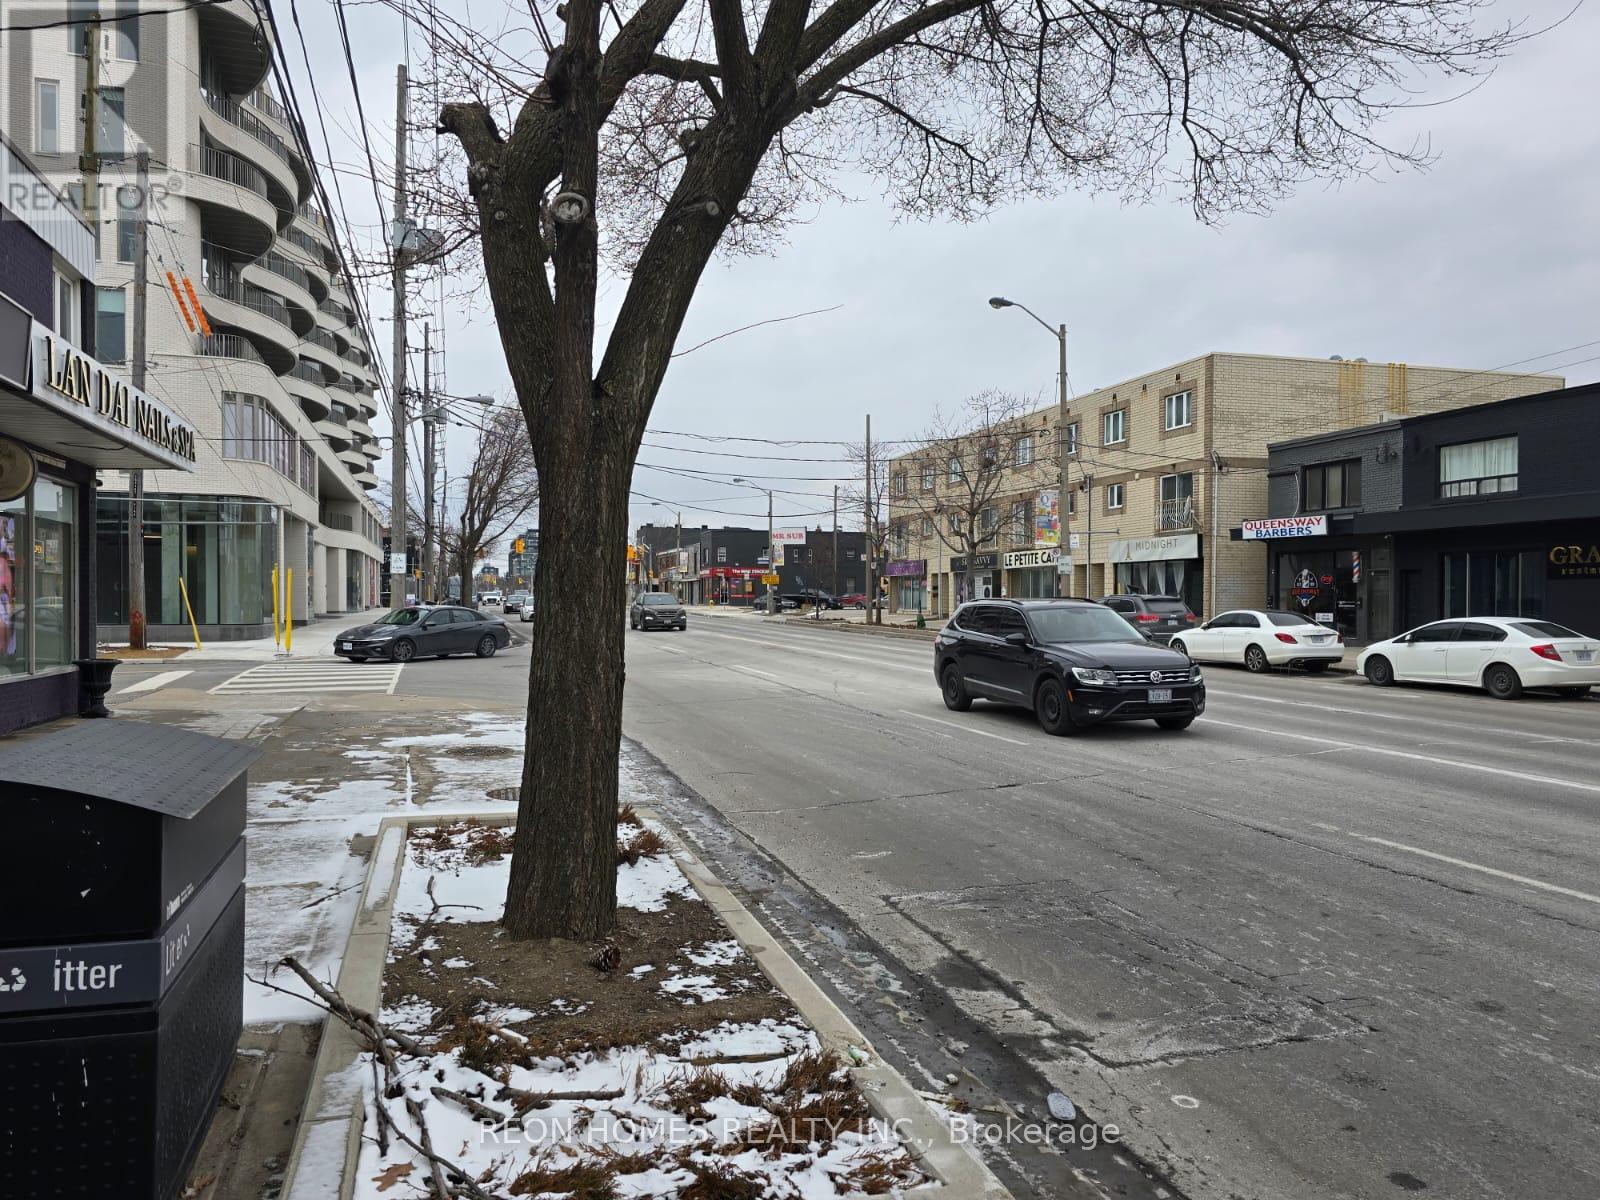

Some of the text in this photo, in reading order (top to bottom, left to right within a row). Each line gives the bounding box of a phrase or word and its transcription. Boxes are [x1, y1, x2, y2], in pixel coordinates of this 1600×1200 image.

[46, 336, 91, 407] LAN
[98, 369, 130, 428] DAI
[135, 396, 170, 448] NAILS
[178, 424, 196, 462] SPA
[1245, 517, 1322, 531] QUEENSWAY
[1255, 526, 1312, 538] BARBERS
[1135, 538, 1179, 551] MIDNIGHT
[1004, 555, 1013, 567] LE
[1014, 552, 1039, 566] PETITE
